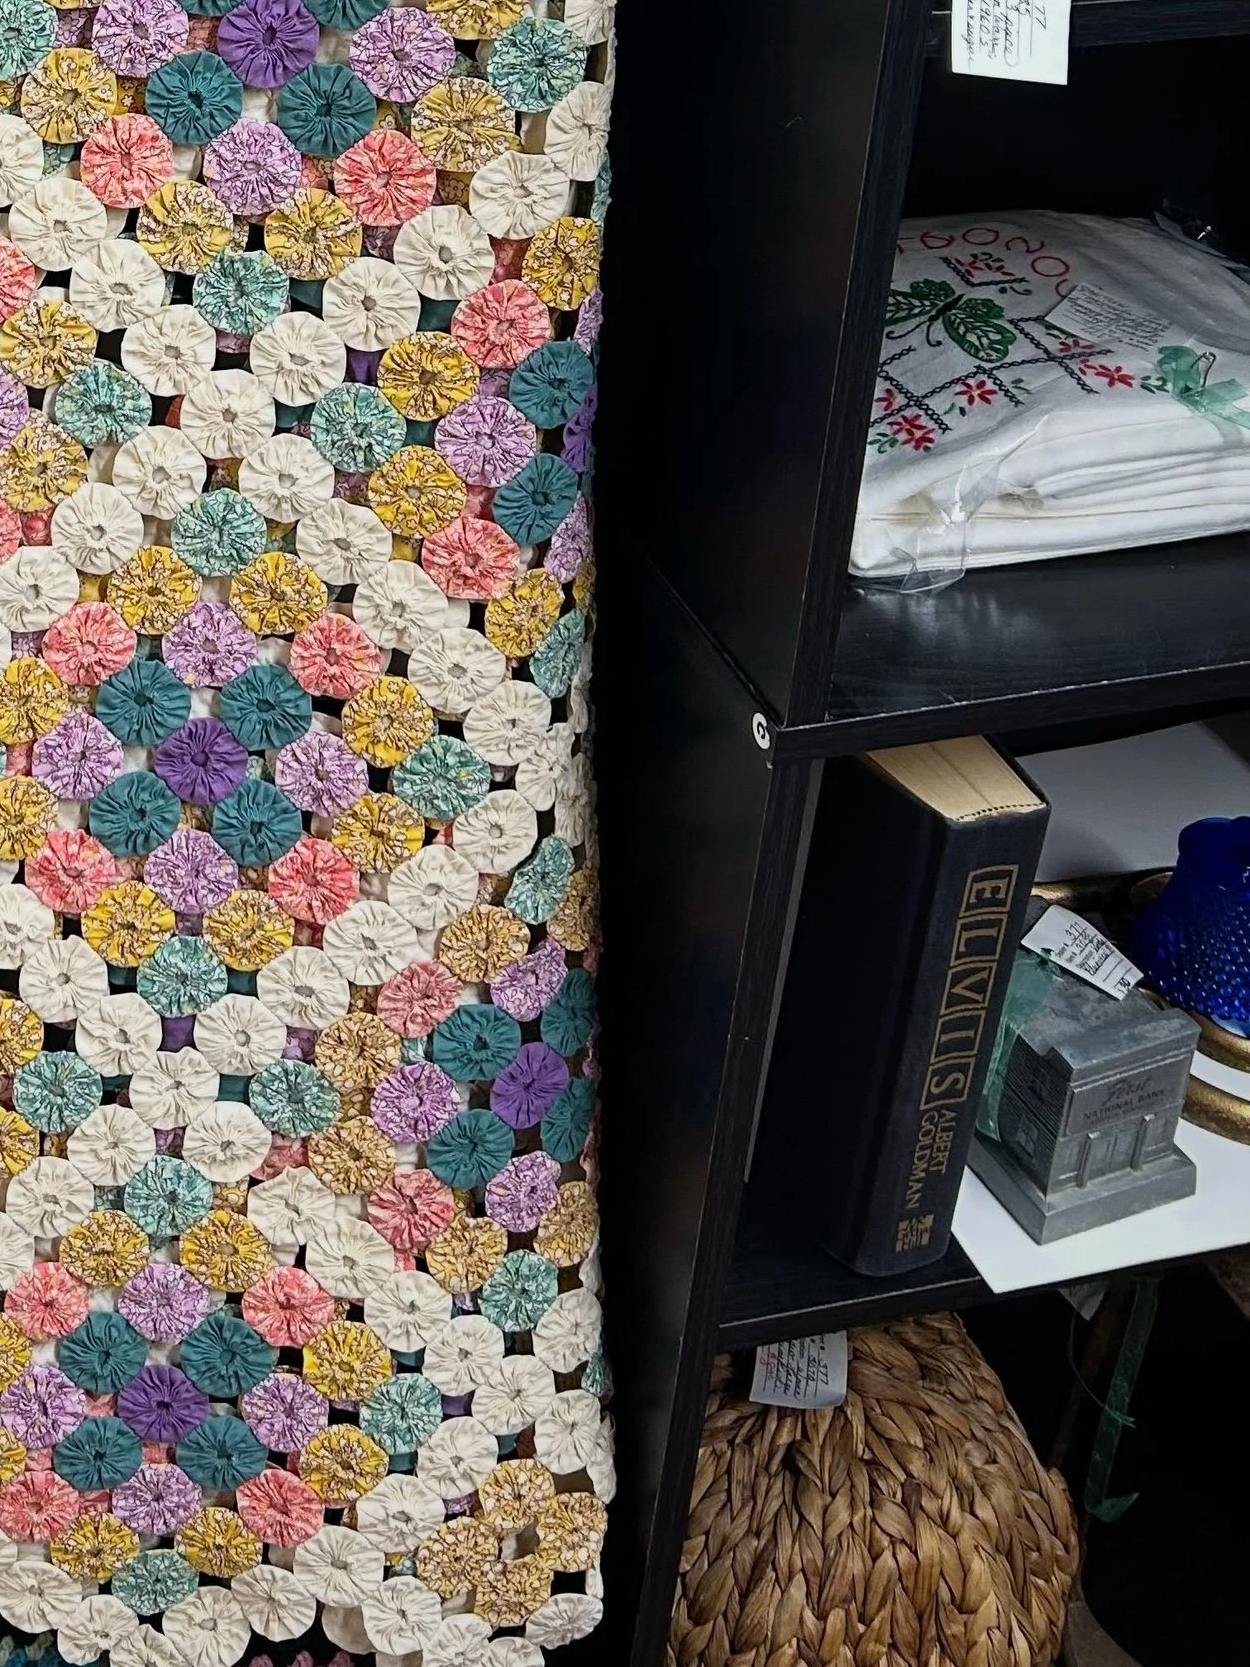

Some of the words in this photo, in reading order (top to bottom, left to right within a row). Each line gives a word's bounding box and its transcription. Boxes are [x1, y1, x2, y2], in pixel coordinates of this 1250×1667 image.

[926, 874, 1012, 1105] ELVIS
[904, 1111, 939, 1211] GOLDMAN
[928, 1108, 959, 1175] ALBERT
